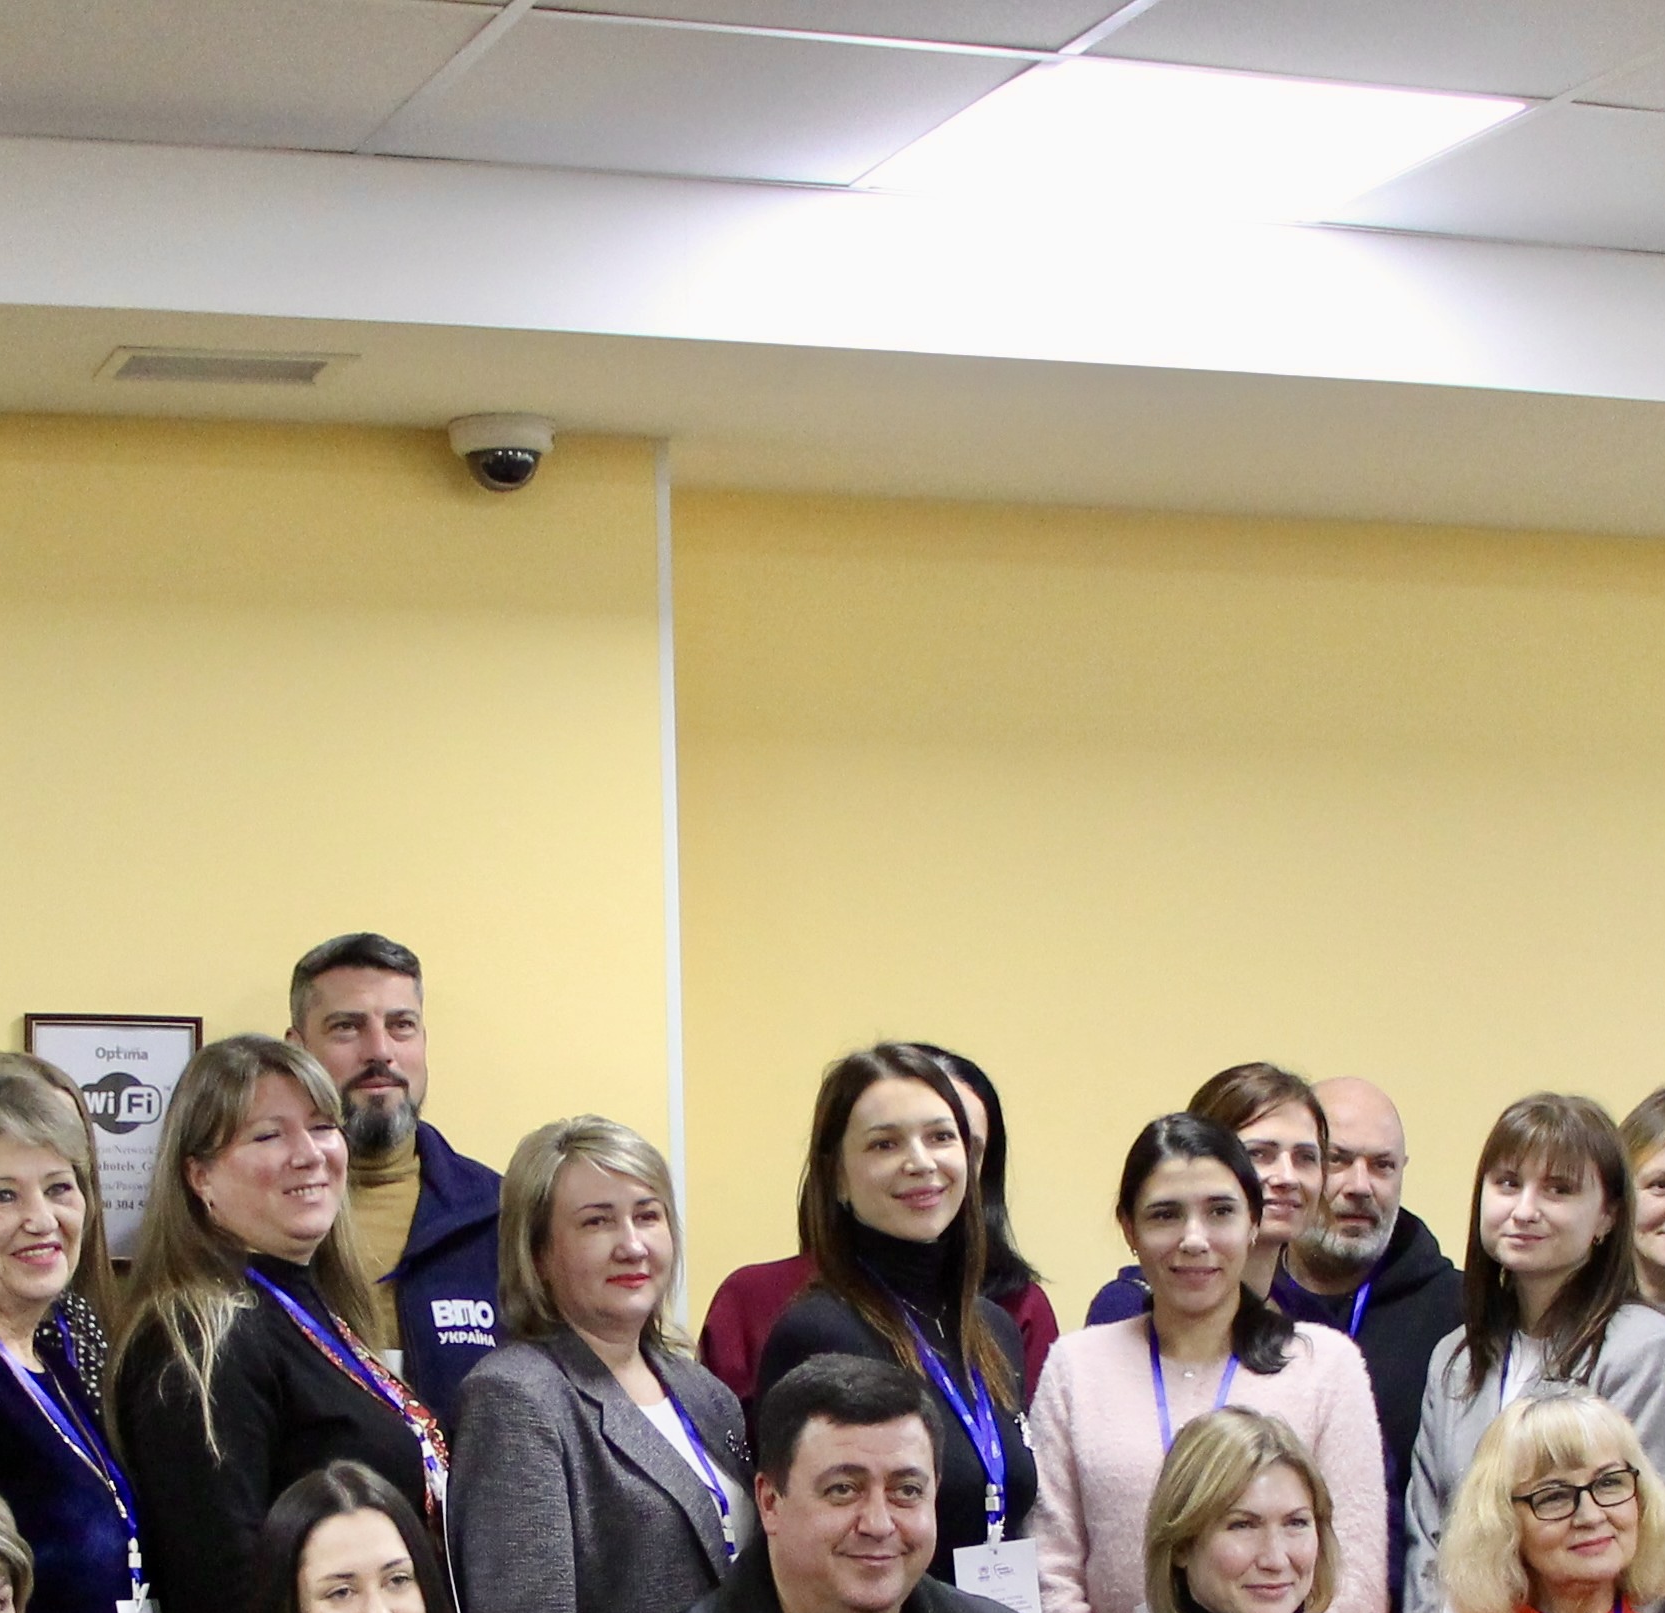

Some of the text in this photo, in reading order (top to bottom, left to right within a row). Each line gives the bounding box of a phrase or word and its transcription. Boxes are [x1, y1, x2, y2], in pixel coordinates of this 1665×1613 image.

[95, 1046, 149, 1061] Optima
[431, 1299, 494, 1329] ВПО
[438, 1329, 496, 1348] УКРАЇНА
